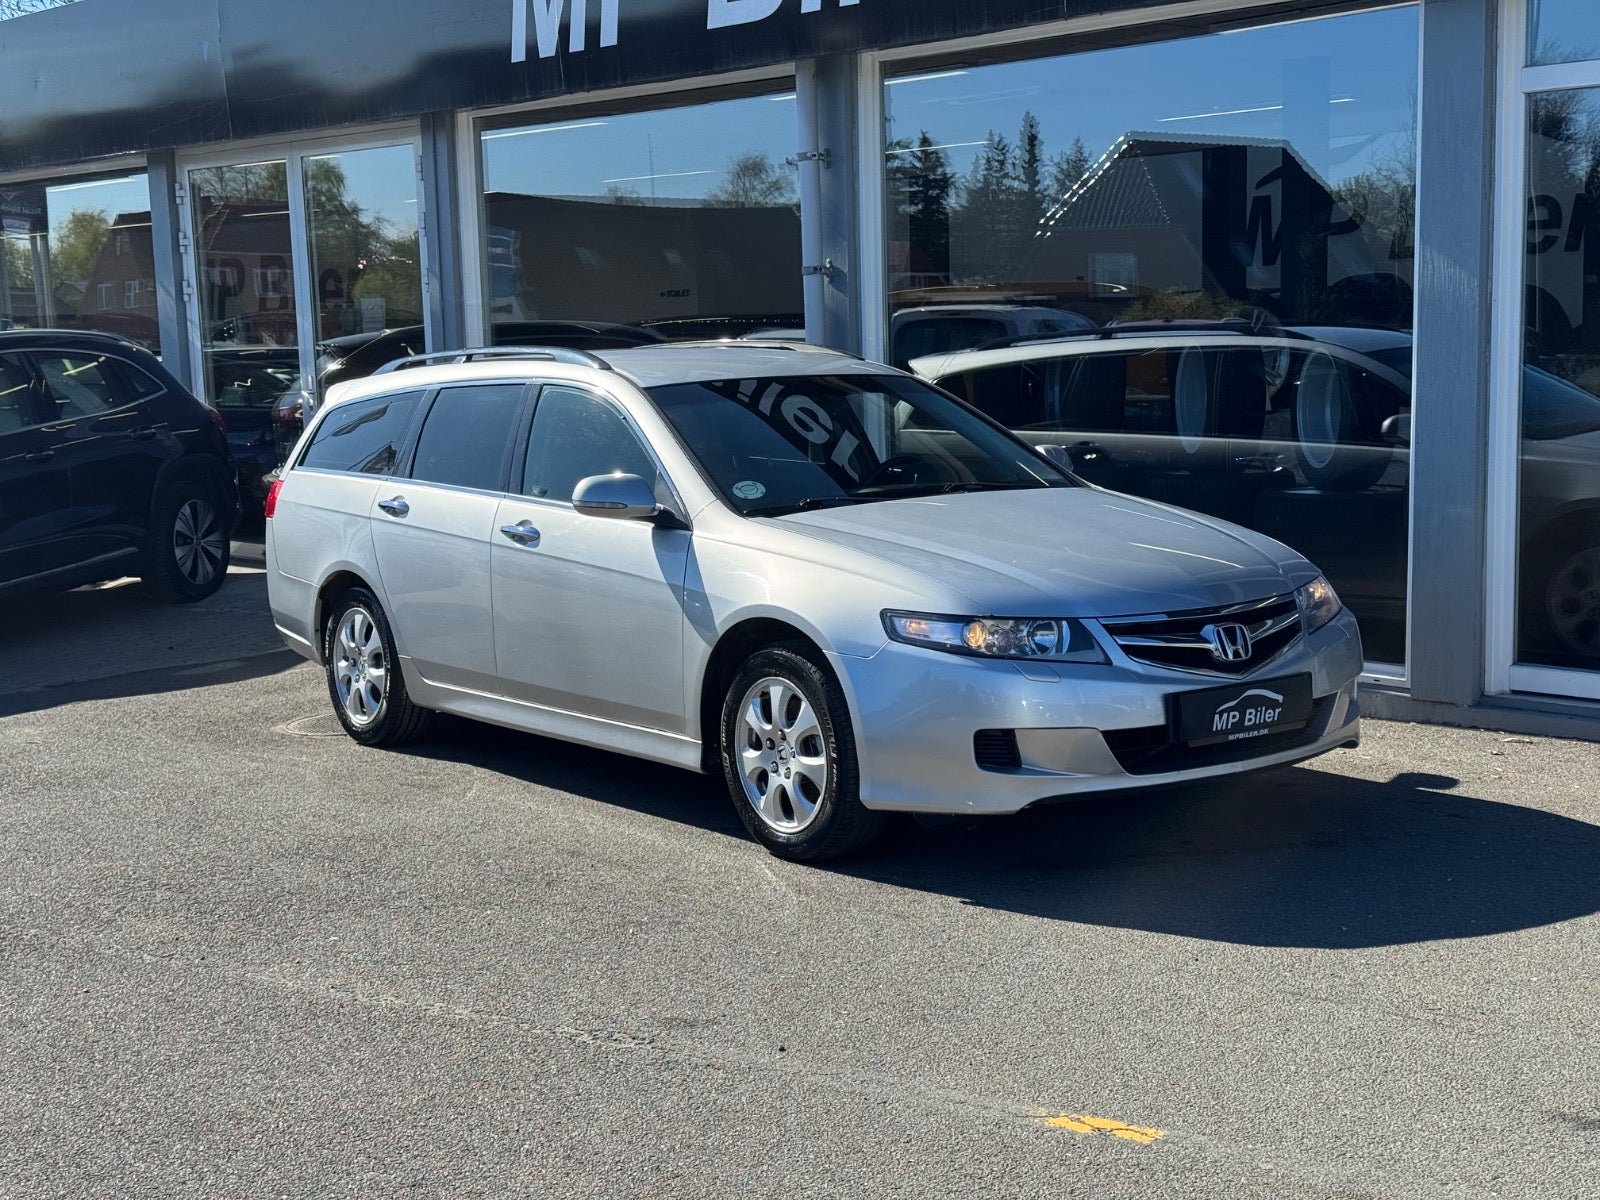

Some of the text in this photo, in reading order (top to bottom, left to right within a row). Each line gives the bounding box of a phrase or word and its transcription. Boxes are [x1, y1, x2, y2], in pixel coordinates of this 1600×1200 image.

[1212, 706, 1282, 732] MP Biler
[1228, 728, 1269, 740] MPBILER.DK
